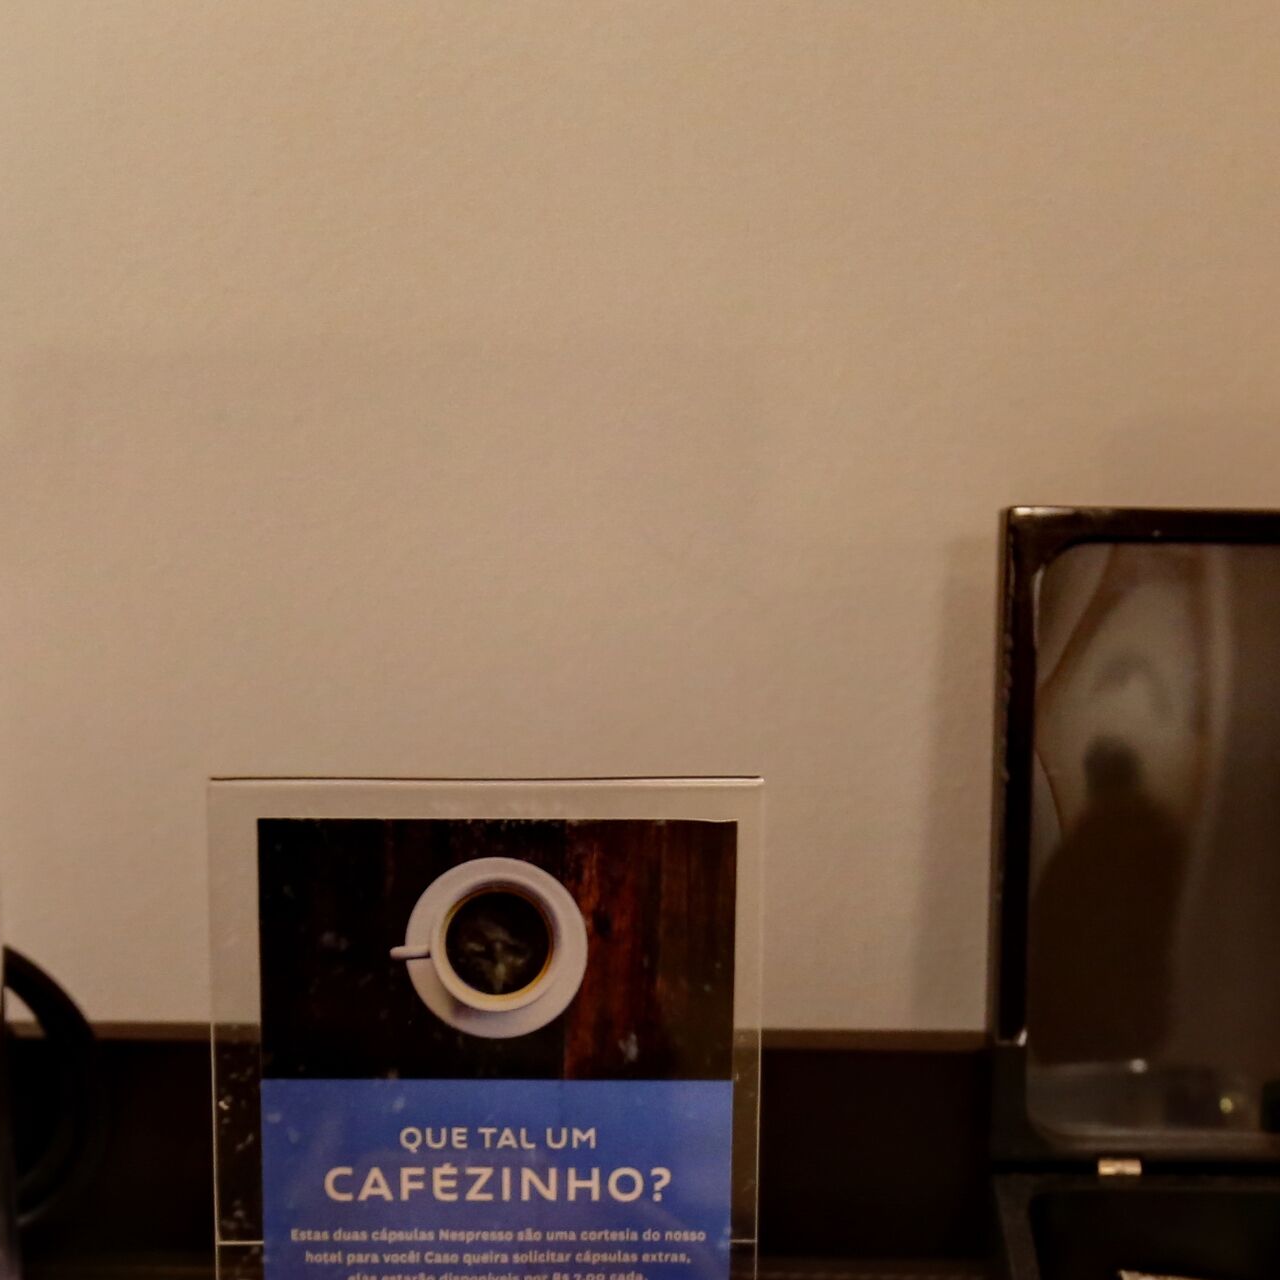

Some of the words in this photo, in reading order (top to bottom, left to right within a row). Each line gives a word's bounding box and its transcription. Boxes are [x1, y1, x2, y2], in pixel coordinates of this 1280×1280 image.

[399, 1126, 468, 1153] QUE
[477, 1127, 537, 1150] TAL
[546, 1127, 597, 1150] UM
[323, 1162, 672, 1203] CAFÉZINHO?
[290, 1228, 330, 1242] Estas
[332, 1228, 368, 1242] duas
[371, 1228, 435, 1244] cápsulas
[438, 1228, 514, 1244] Nespresso
[516, 1228, 542, 1242] são
[546, 1230, 577, 1242] uma
[580, 1228, 639, 1242] cortesia
[642, 1228, 661, 1242] do
[664, 1230, 707, 1243] nosso
[304, 1250, 343, 1264] hotel
[346, 1253, 380, 1266] para
[424, 1251, 459, 1264] Caso
[462, 1251, 509, 1266] queira
[512, 1250, 572, 1264] solicitar
[575, 1250, 639, 1265] cápsulas
